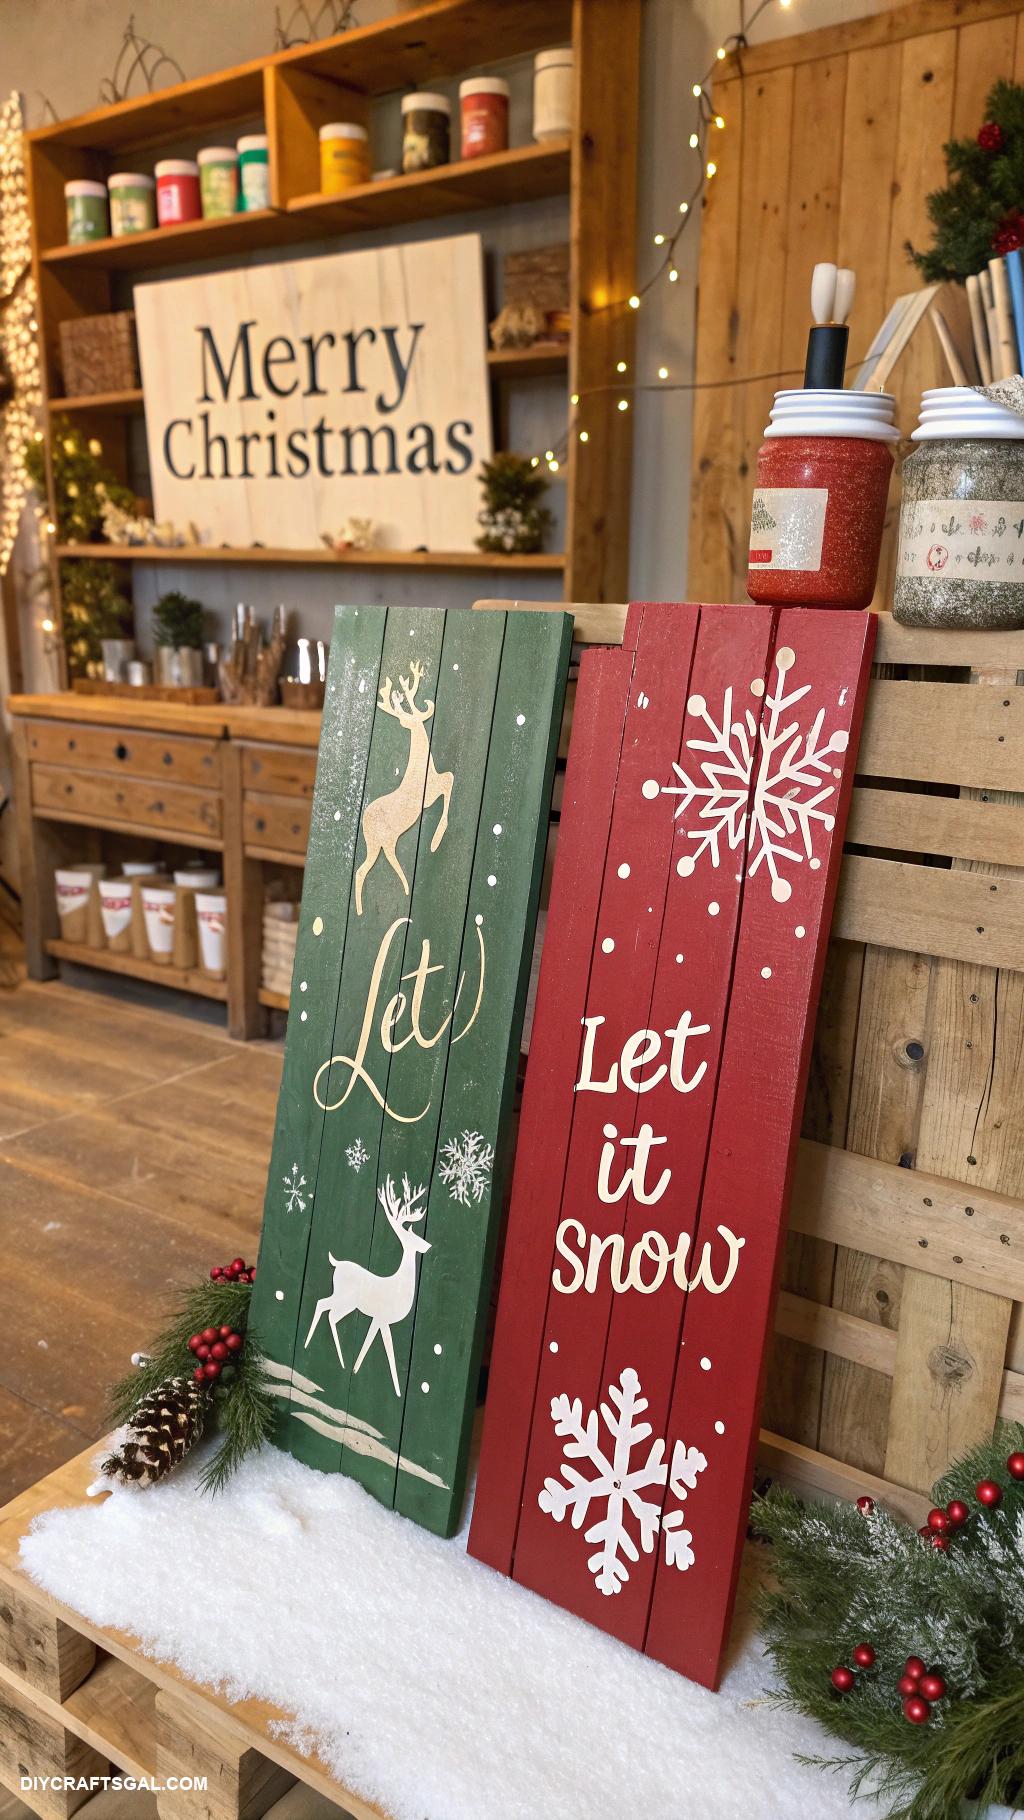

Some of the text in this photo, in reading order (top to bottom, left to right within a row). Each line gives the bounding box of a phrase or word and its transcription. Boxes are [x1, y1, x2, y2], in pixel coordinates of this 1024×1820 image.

[196, 320, 425, 414] Merry
[163, 410, 475, 480] Christmas
[574, 1010, 711, 1093] Let
[596, 1123, 672, 1205] it
